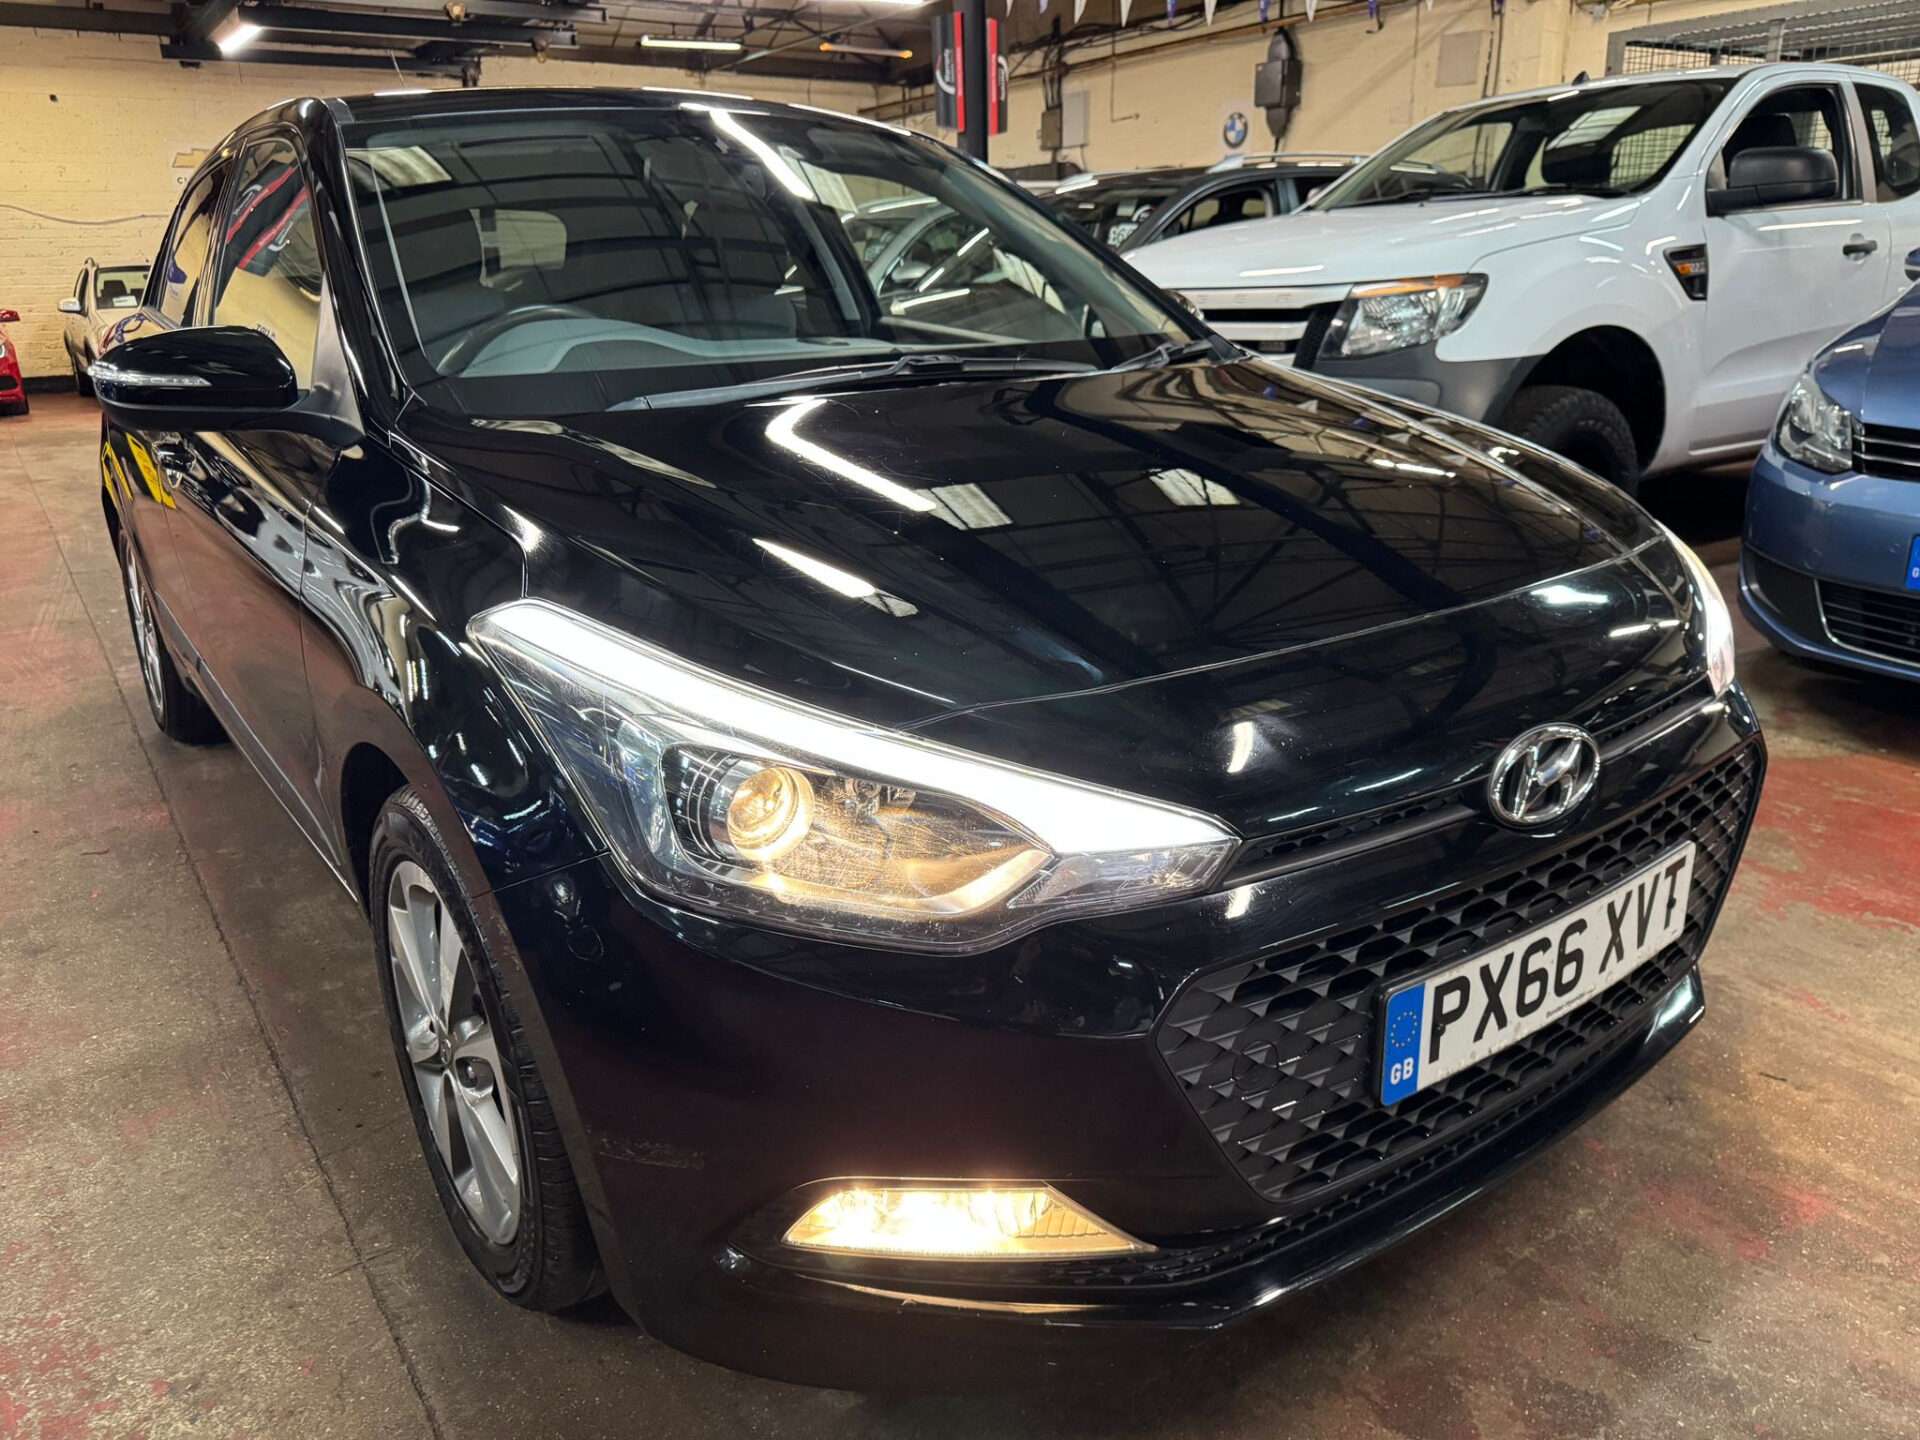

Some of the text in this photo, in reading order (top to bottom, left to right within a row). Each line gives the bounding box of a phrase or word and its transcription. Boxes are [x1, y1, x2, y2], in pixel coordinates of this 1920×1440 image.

[1428, 856, 1687, 1064] PX66 XVT
[1390, 1057, 1415, 1085] GB
